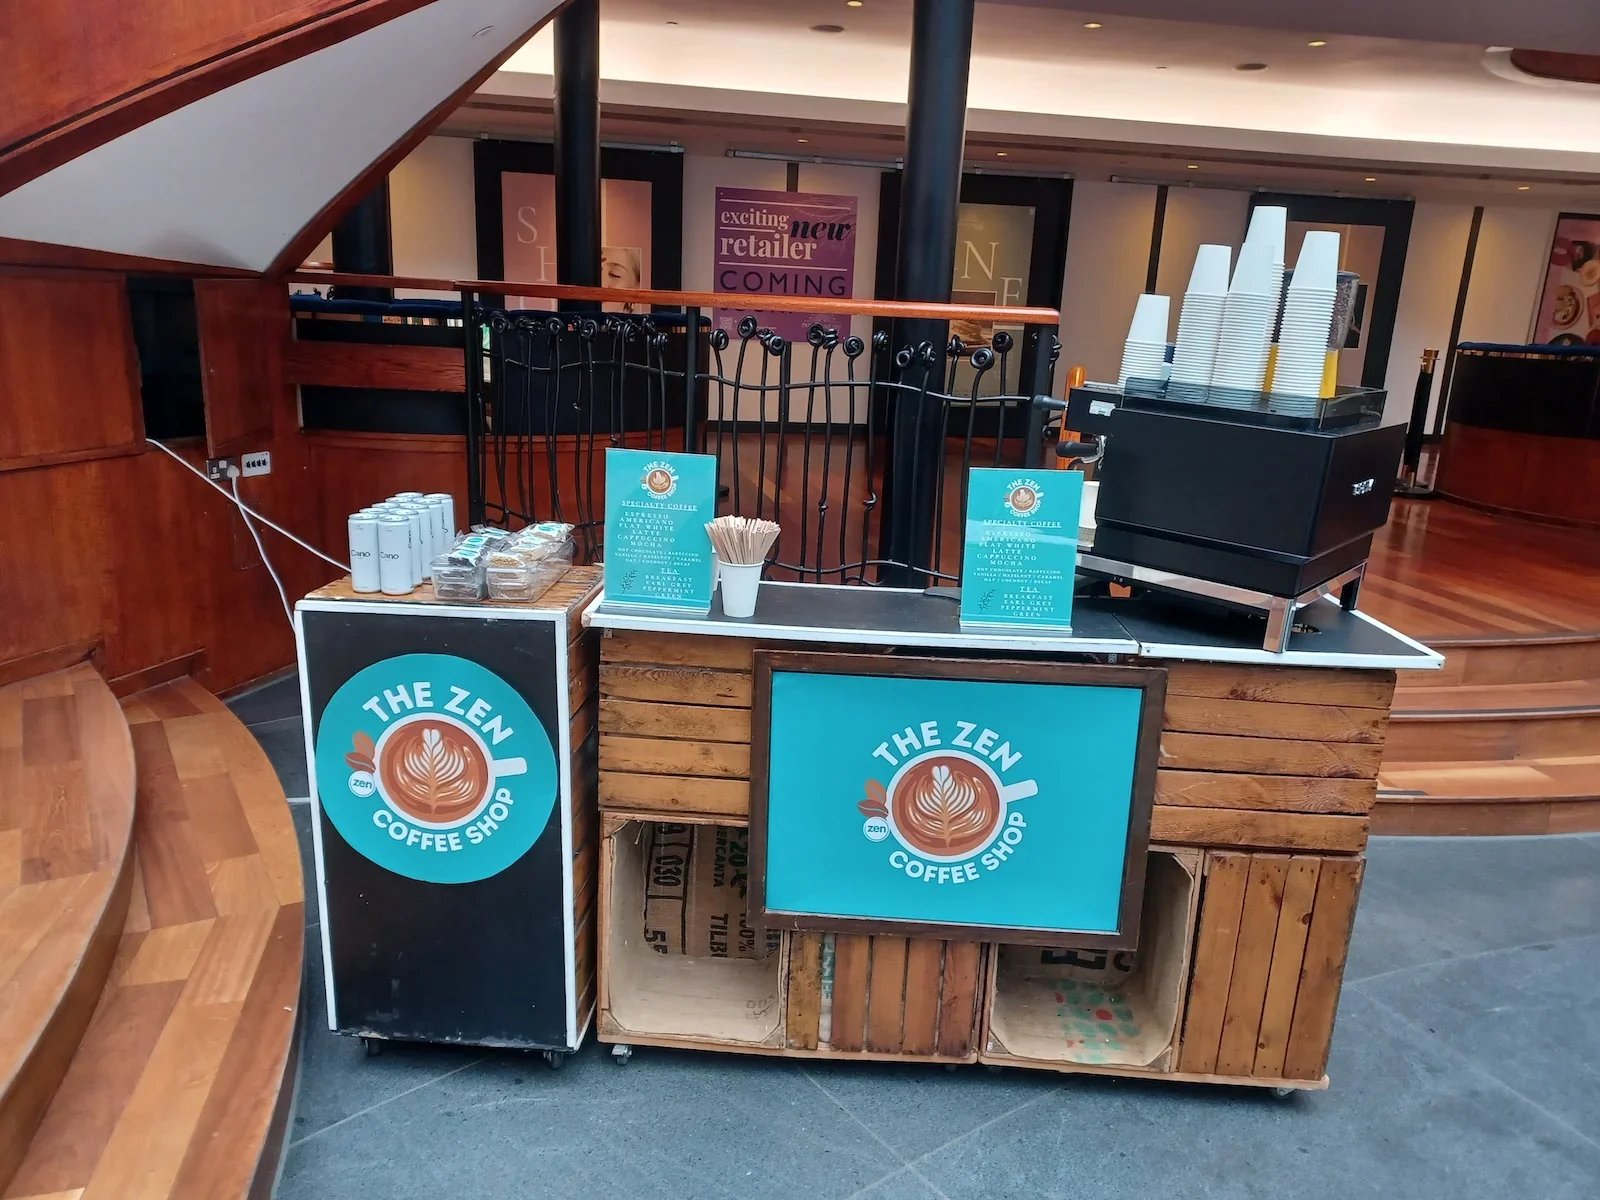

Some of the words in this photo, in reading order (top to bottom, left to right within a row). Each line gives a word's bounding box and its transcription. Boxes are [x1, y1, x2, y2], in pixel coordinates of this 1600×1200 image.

[721, 208, 789, 230] exciting
[791, 220, 851, 241] new
[720, 233, 817, 260] retailer
[720, 270, 845, 296] COMING
[643, 461, 659, 473] THE
[660, 461, 675, 473] ZEN
[647, 492, 668, 500] COFFEE
[667, 482, 678, 497] SHOP
[1007, 479, 1023, 490] THE
[1025, 479, 1040, 491] ZEN
[622, 500, 665, 508] SPECIALTY
[1010, 510, 1030, 518] COFFEE
[1031, 500, 1042, 515] SHOP
[617, 535, 675, 543] CAPPUCCINO
[351, 549, 371, 557] Cano
[380, 551, 399, 560] Cano
[643, 586, 694, 594] PEPPERMINT
[362, 682, 434, 722] THE
[443, 685, 514, 745] ZEN
[872, 720, 941, 766] THE
[951, 720, 1023, 772] ZEN
[353, 779, 373, 790] zen
[373, 809, 463, 852] COFFEE
[465, 787, 514, 844] SHOP
[867, 824, 887, 833] zen
[889, 851, 980, 884] COFFEE
[981, 812, 1027, 870] SHOP
[653, 855, 684, 887] 030
